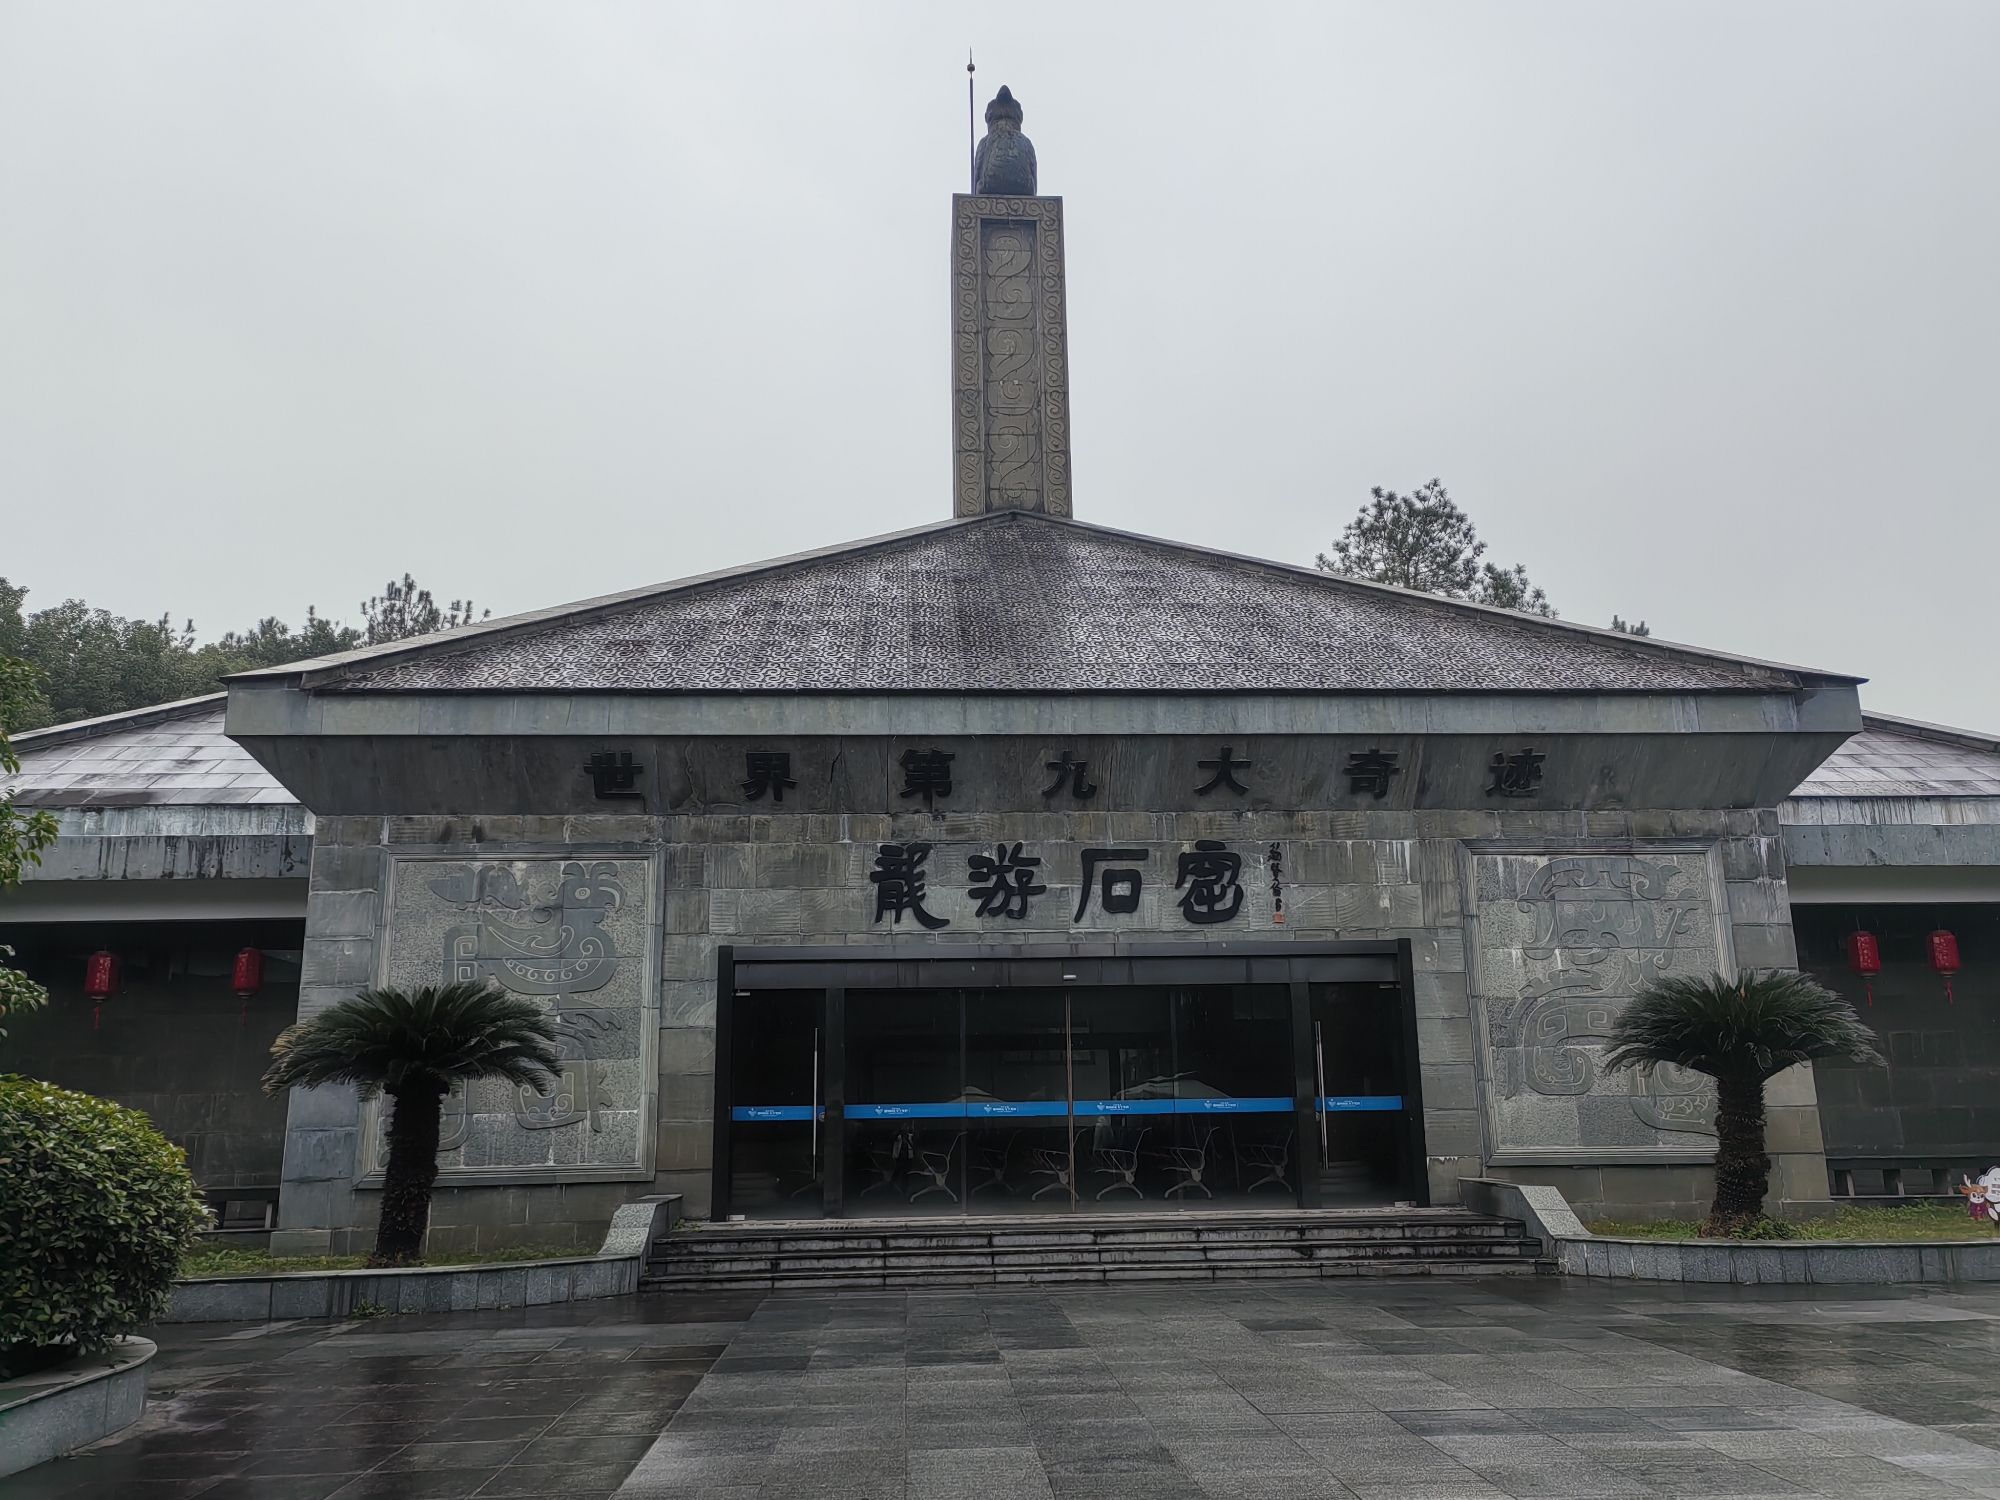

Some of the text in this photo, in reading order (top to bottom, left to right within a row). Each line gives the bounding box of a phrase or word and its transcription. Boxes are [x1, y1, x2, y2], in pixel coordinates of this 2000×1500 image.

[583, 747, 1546, 801] 世界第九大奇迹
